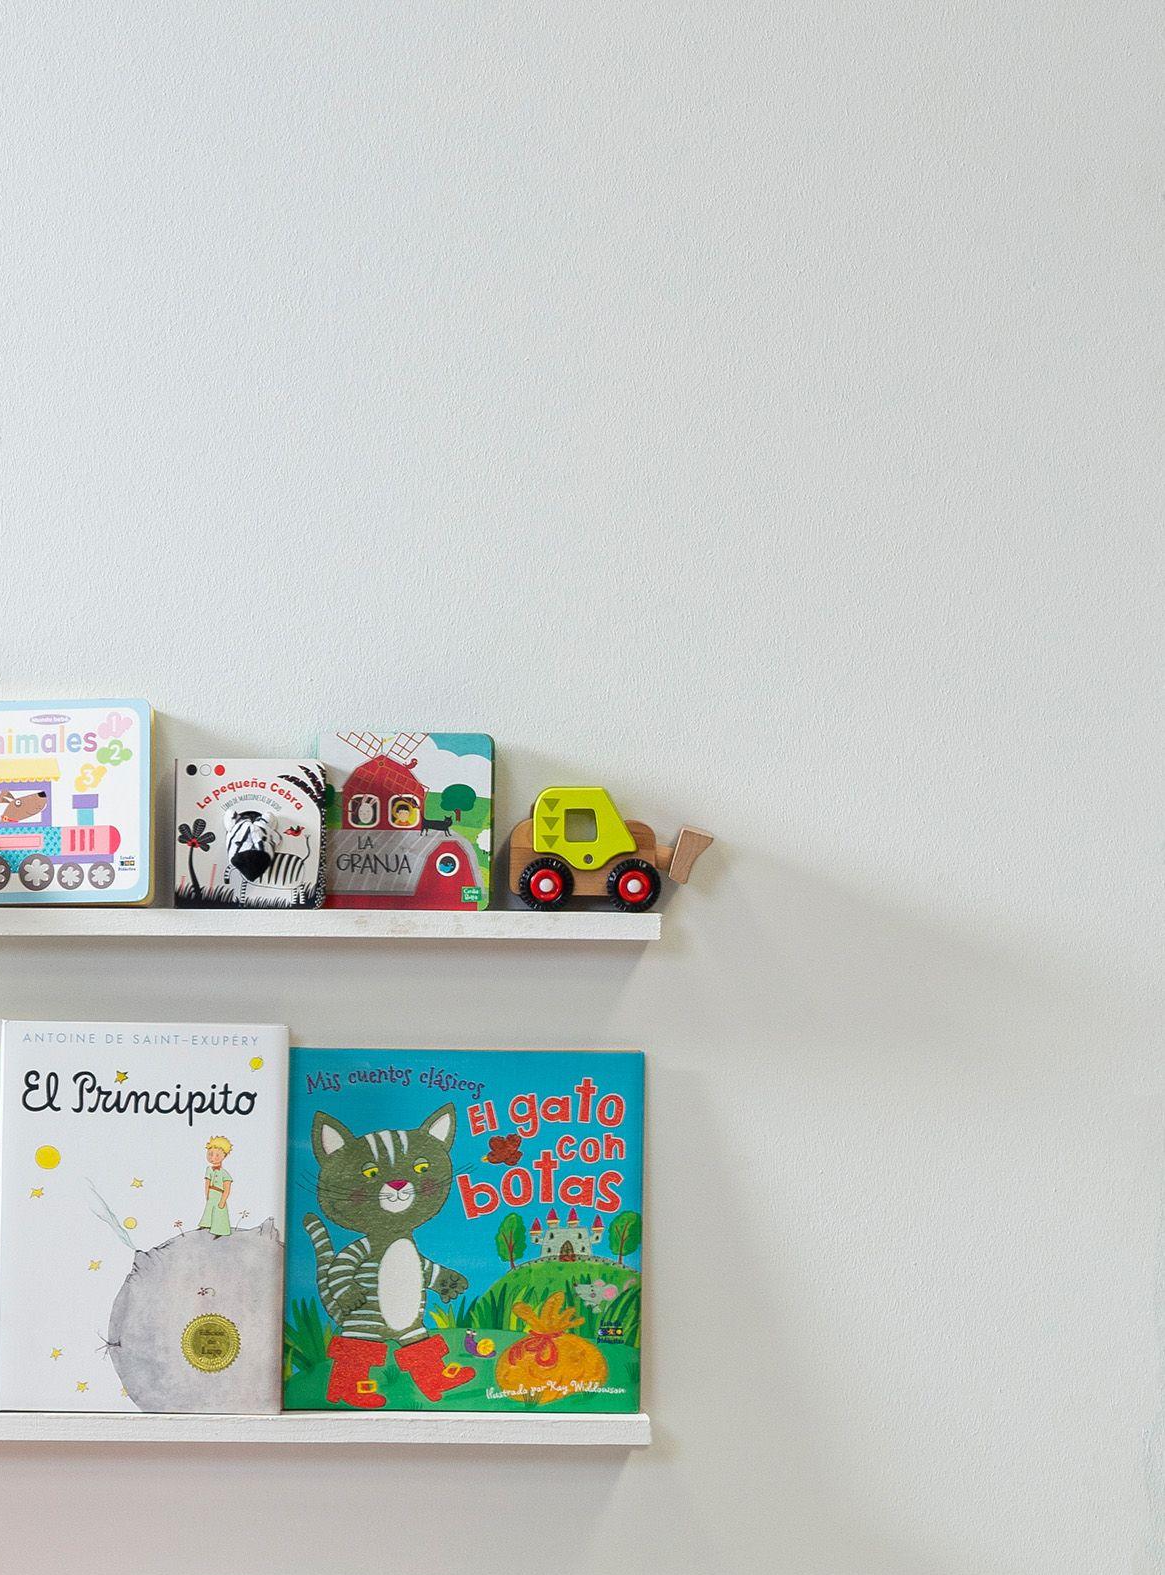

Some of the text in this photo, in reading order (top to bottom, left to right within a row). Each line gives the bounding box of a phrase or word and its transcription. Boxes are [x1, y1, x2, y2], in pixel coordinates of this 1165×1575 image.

[109, 744, 121, 760] 2
[82, 768, 94, 785] 3
[196, 778, 303, 810] La pequeña Cebra
[357, 836, 374, 850] LA
[336, 853, 412, 875] GRANJA
[22, 1033, 95, 1044] ANTOINE
[105, 1034, 123, 1044] DE
[22, 1070, 258, 1127] El Principito
[306, 1066, 486, 1100] Mis cuentos clásicos
[467, 1077, 625, 1138] El gato
[555, 1133, 626, 1164] con
[455, 1150, 624, 1220] botas
